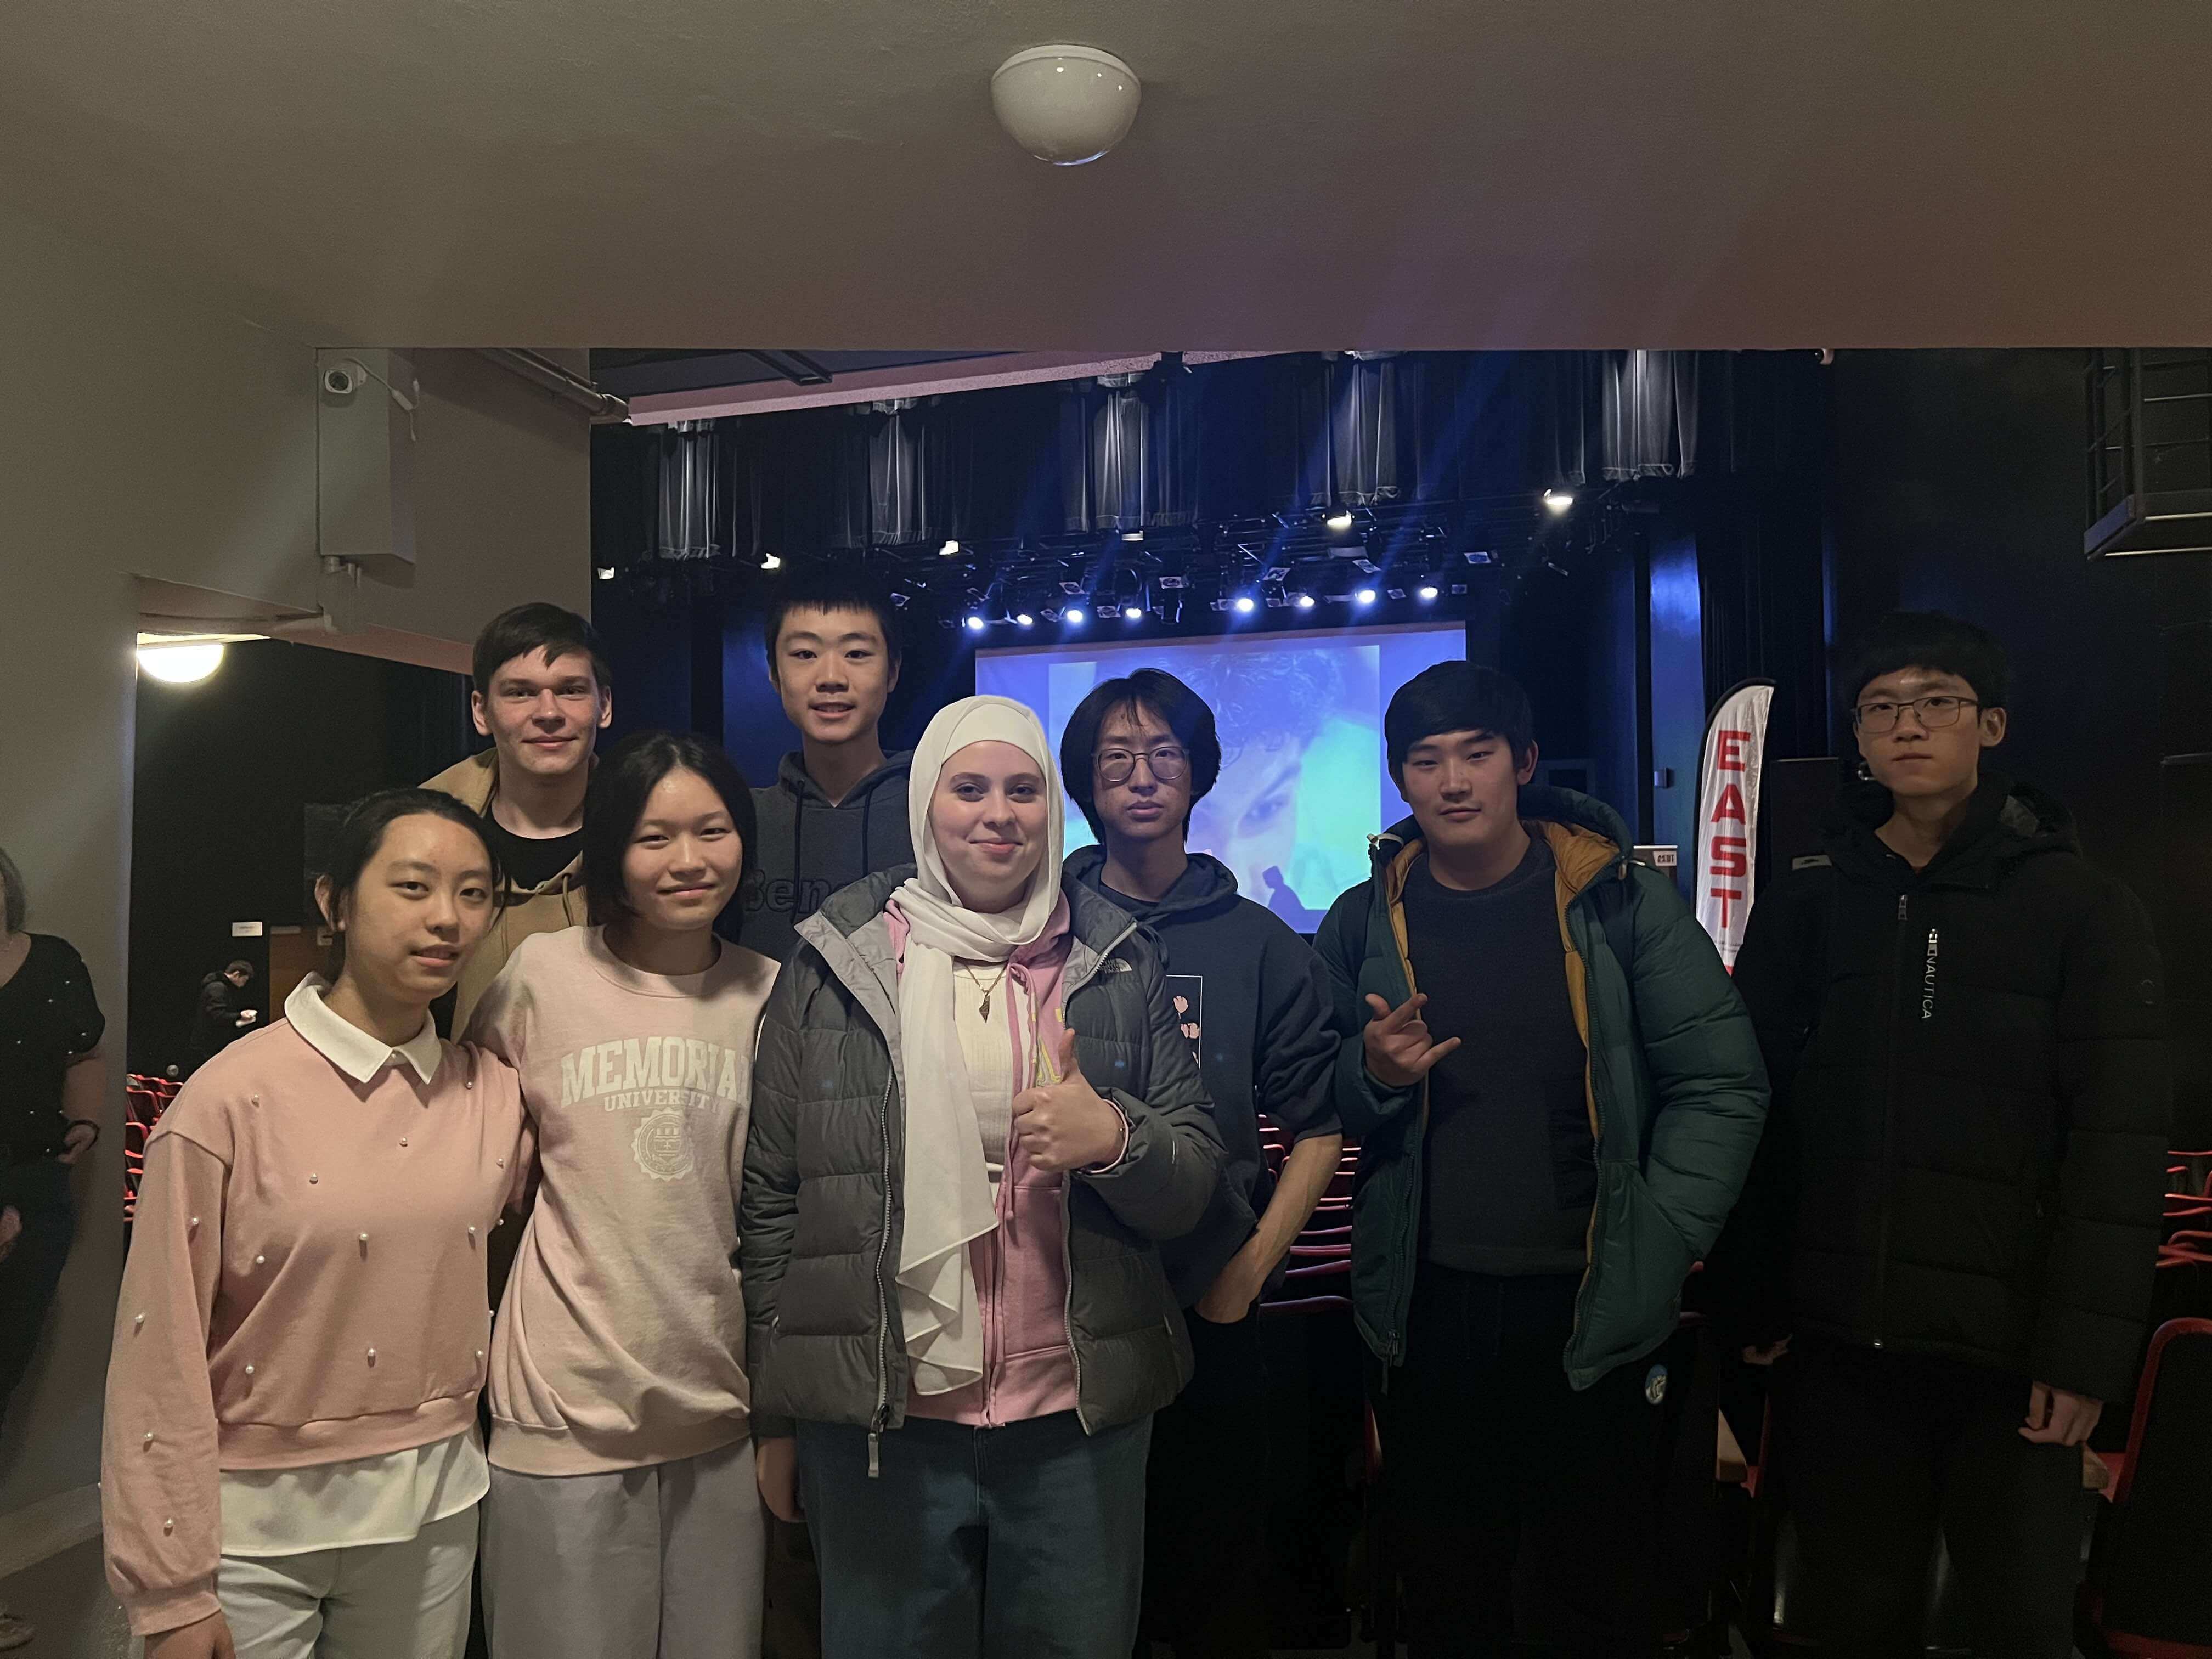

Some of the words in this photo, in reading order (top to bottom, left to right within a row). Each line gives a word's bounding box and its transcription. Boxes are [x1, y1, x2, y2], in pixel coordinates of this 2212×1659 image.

[1709, 730, 1751, 928] EAST
[744, 868, 851, 915] Ben
[1922, 956, 1937, 1019] NAUTICA
